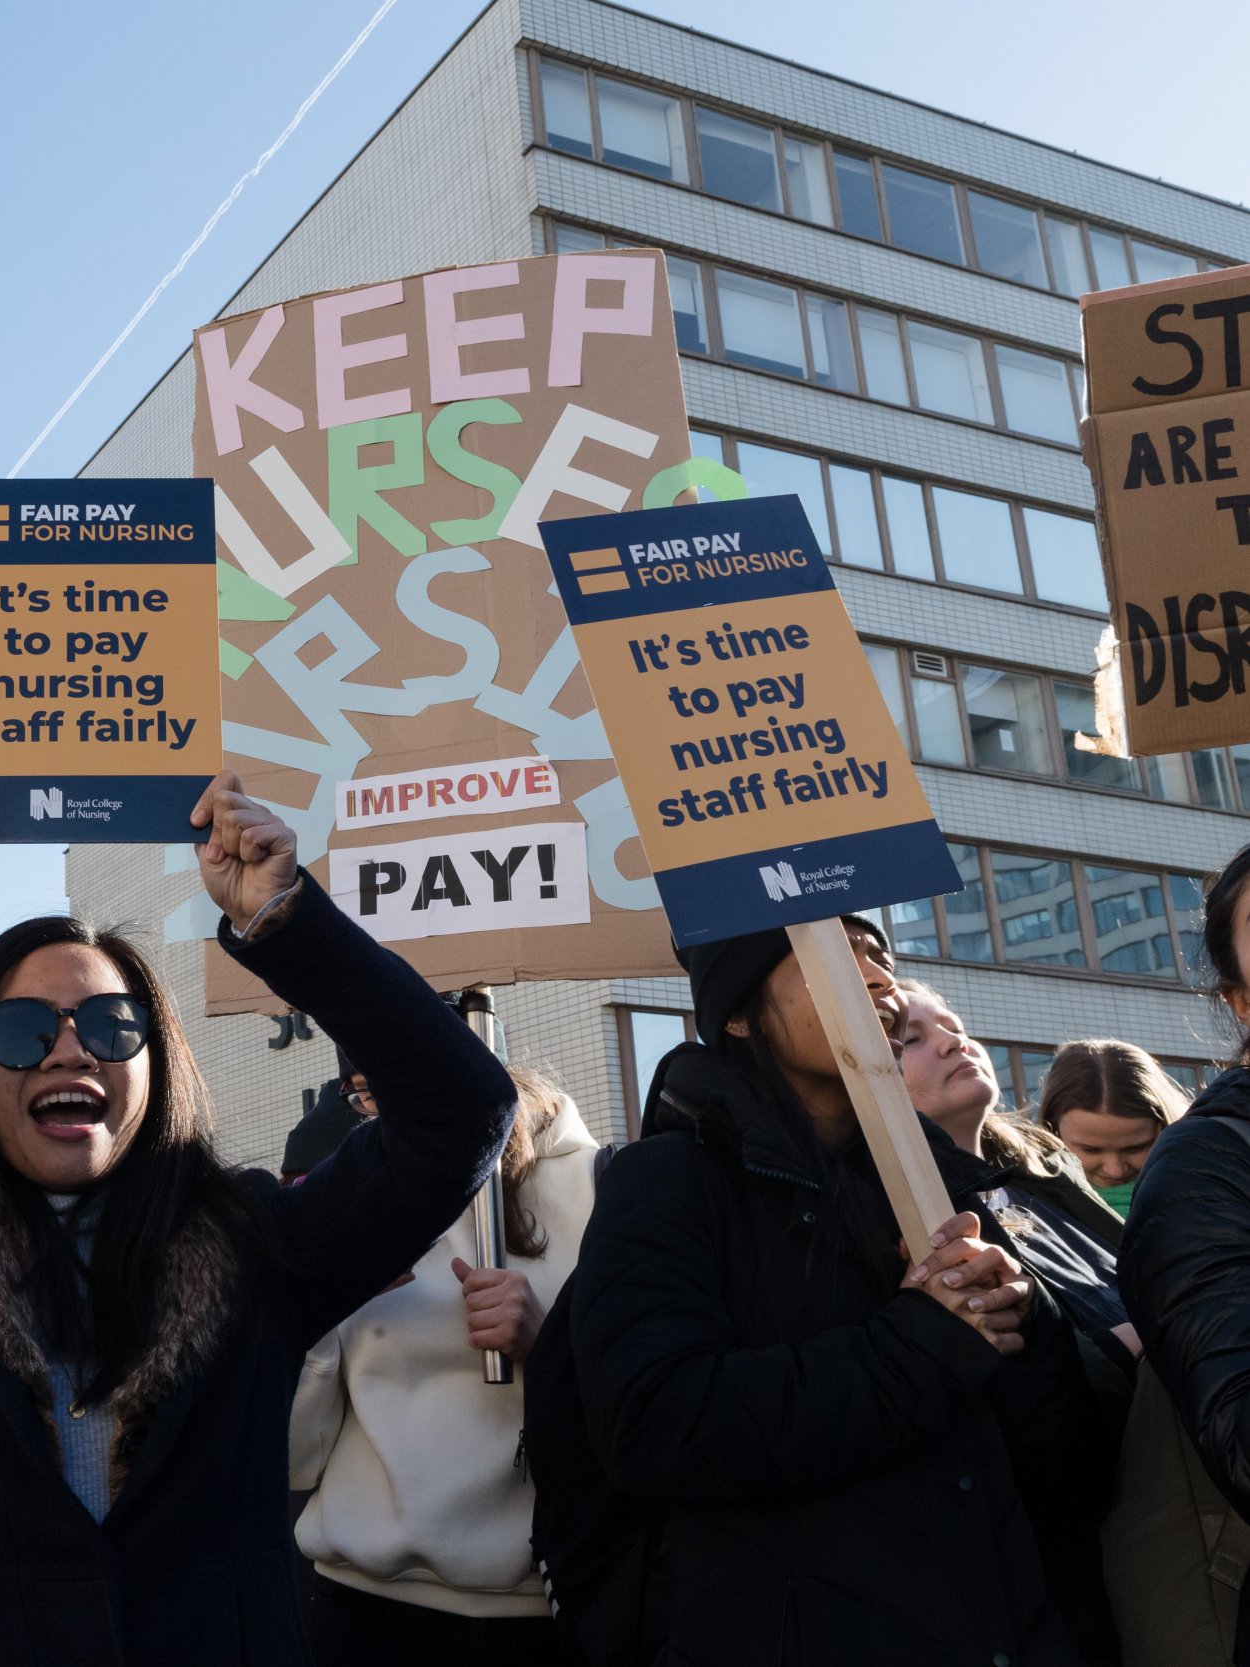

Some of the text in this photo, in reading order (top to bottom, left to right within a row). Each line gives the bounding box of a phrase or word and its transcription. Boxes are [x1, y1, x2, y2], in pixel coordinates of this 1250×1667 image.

[198, 254, 656, 456] KEEP
[1123, 418, 1238, 490] ARE
[21, 504, 136, 522] FAIR PAY
[21, 524, 194, 542] FOR NURSING
[628, 532, 740, 564] FAIR PAY
[638, 549, 808, 587] FOR NURSING
[64, 580, 168, 612] time
[4, 628, 148, 662] to pay
[628, 622, 810, 673] It’s time
[668, 672, 804, 718] to pay
[77, 709, 197, 750] fairly
[670, 716, 846, 771] nursing
[67, 799, 123, 810] Royal College
[346, 765, 551, 818] IMPROVE
[658, 757, 888, 827] staff fairly
[67, 810, 110, 821] of Nursing
[359, 844, 557, 916] PAY!
[800, 865, 856, 883] Royal College
[805, 879, 849, 894] of Nursing
